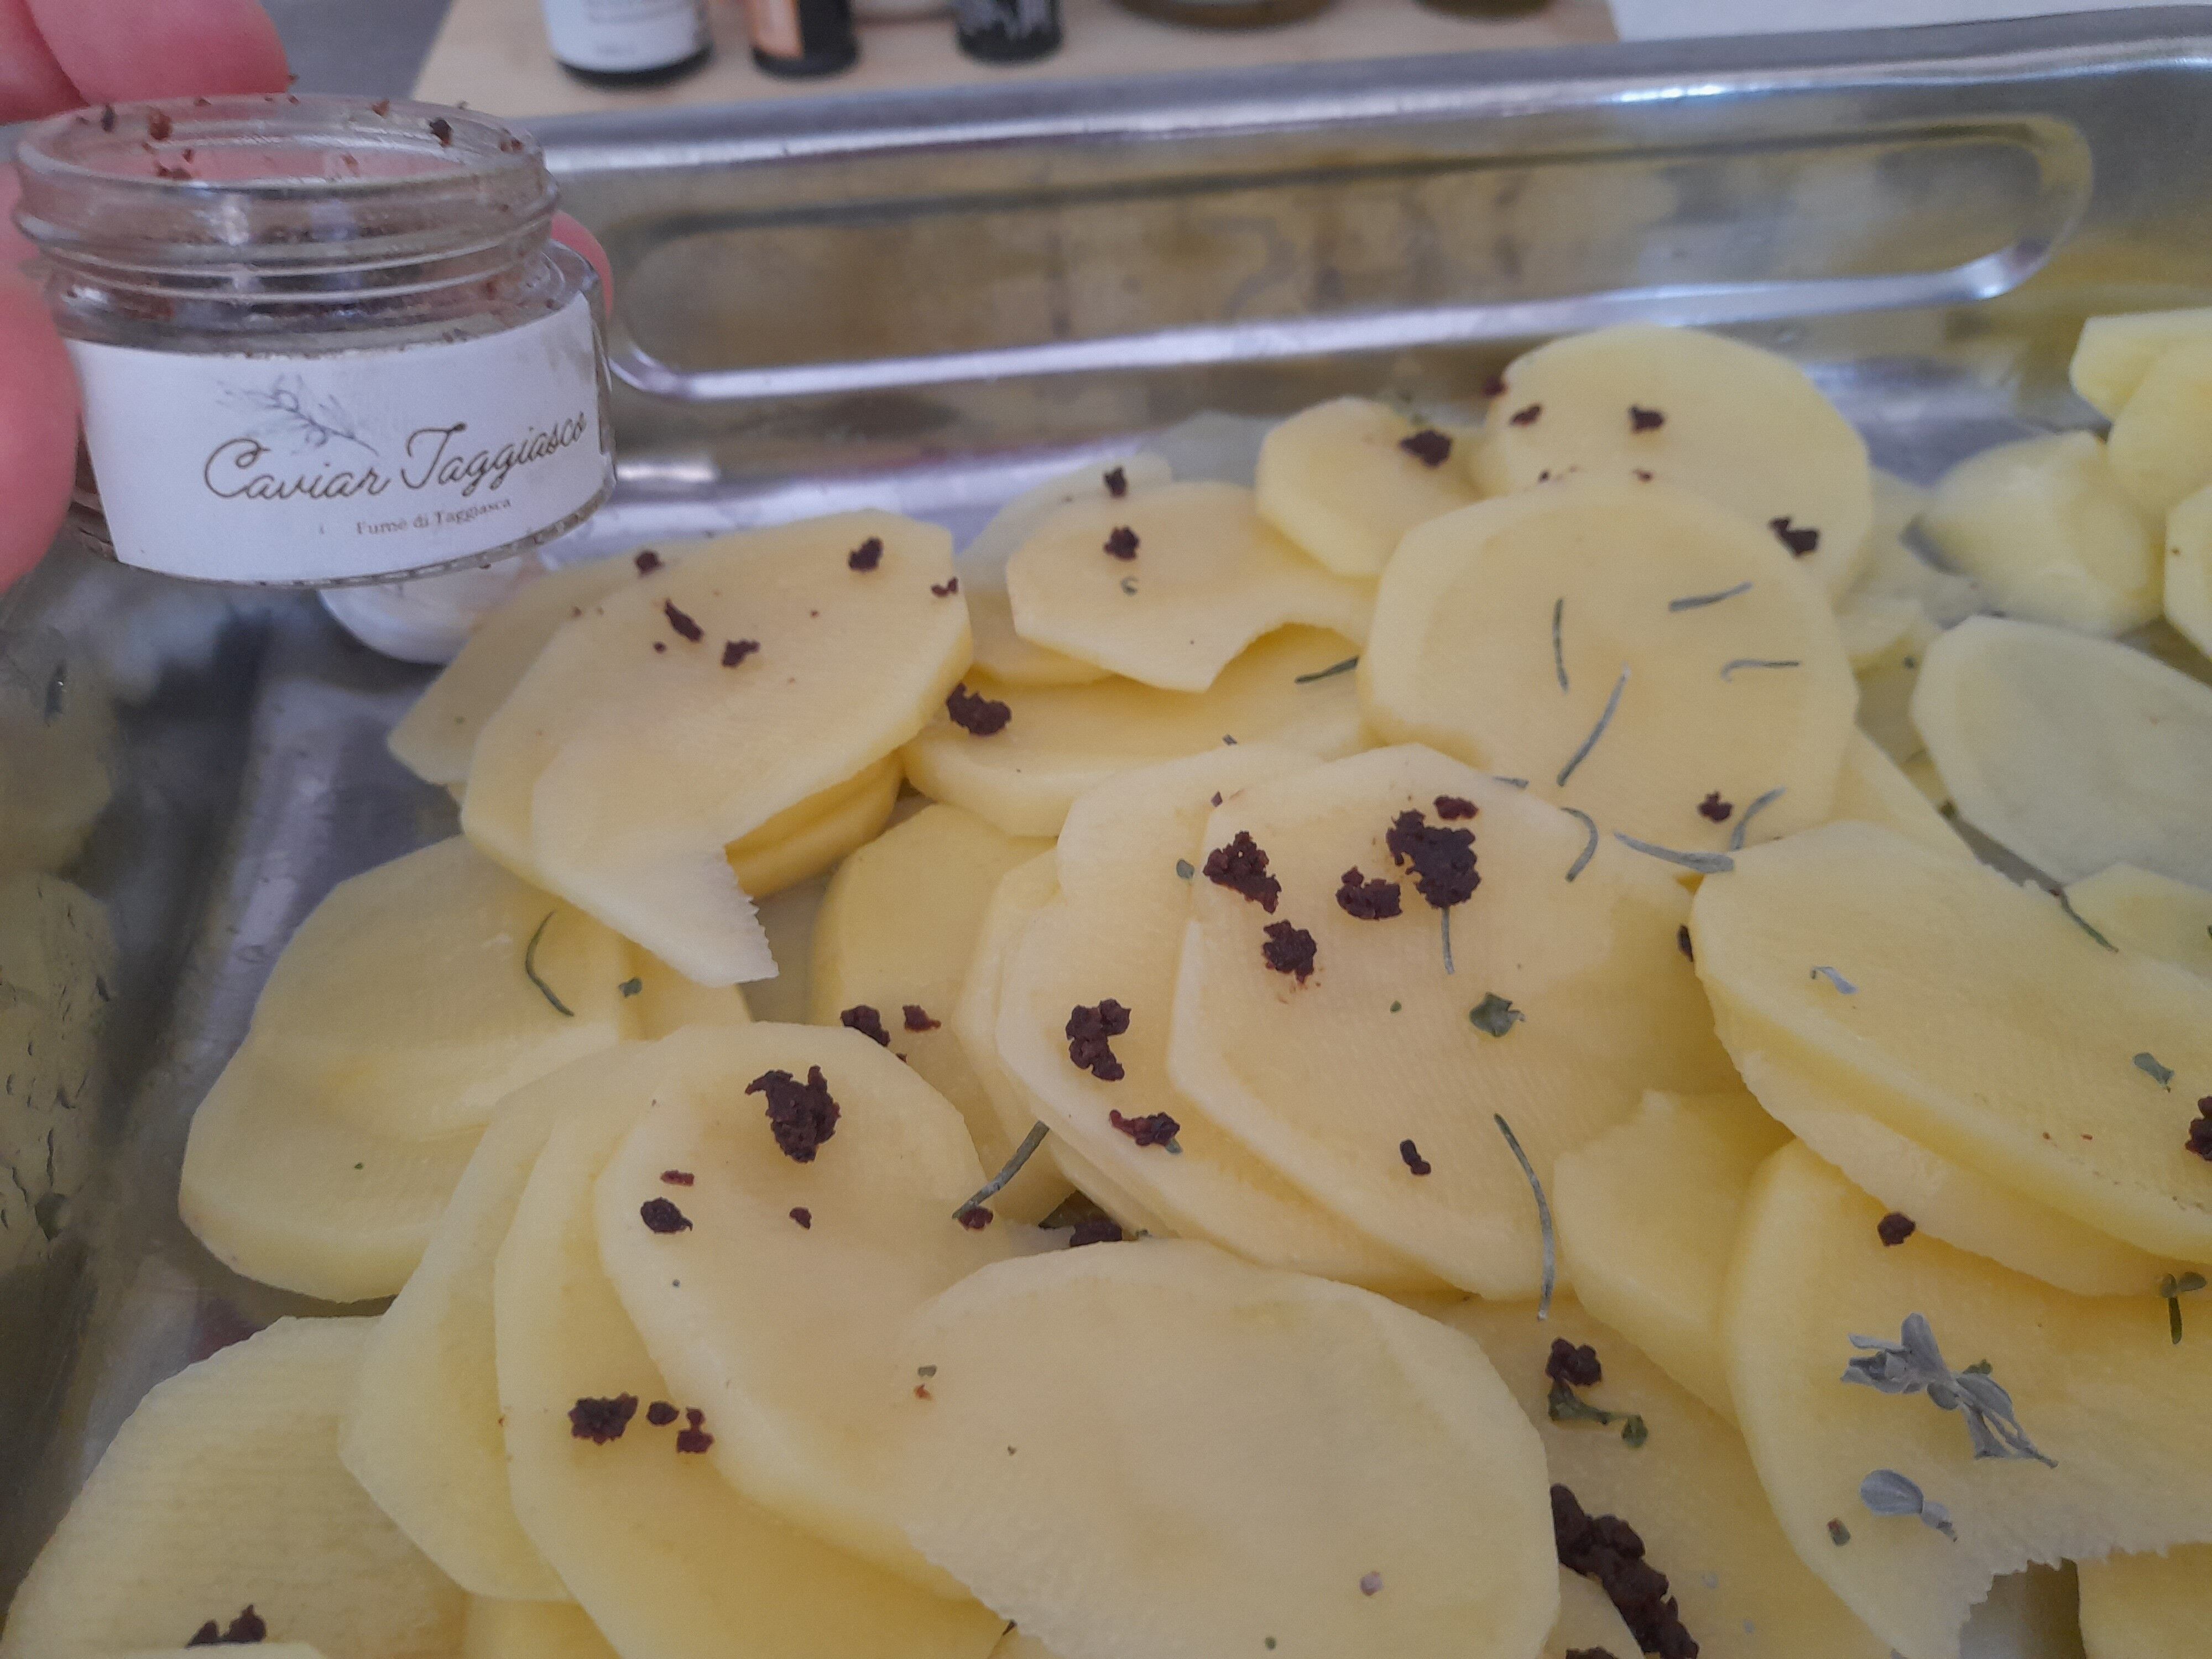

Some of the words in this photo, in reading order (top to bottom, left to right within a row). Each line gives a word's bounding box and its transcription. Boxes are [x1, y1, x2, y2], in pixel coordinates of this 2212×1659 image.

[204, 436, 390, 499] Caviar
[400, 411, 586, 497] Taggiasco
[413, 513, 429, 528] di
